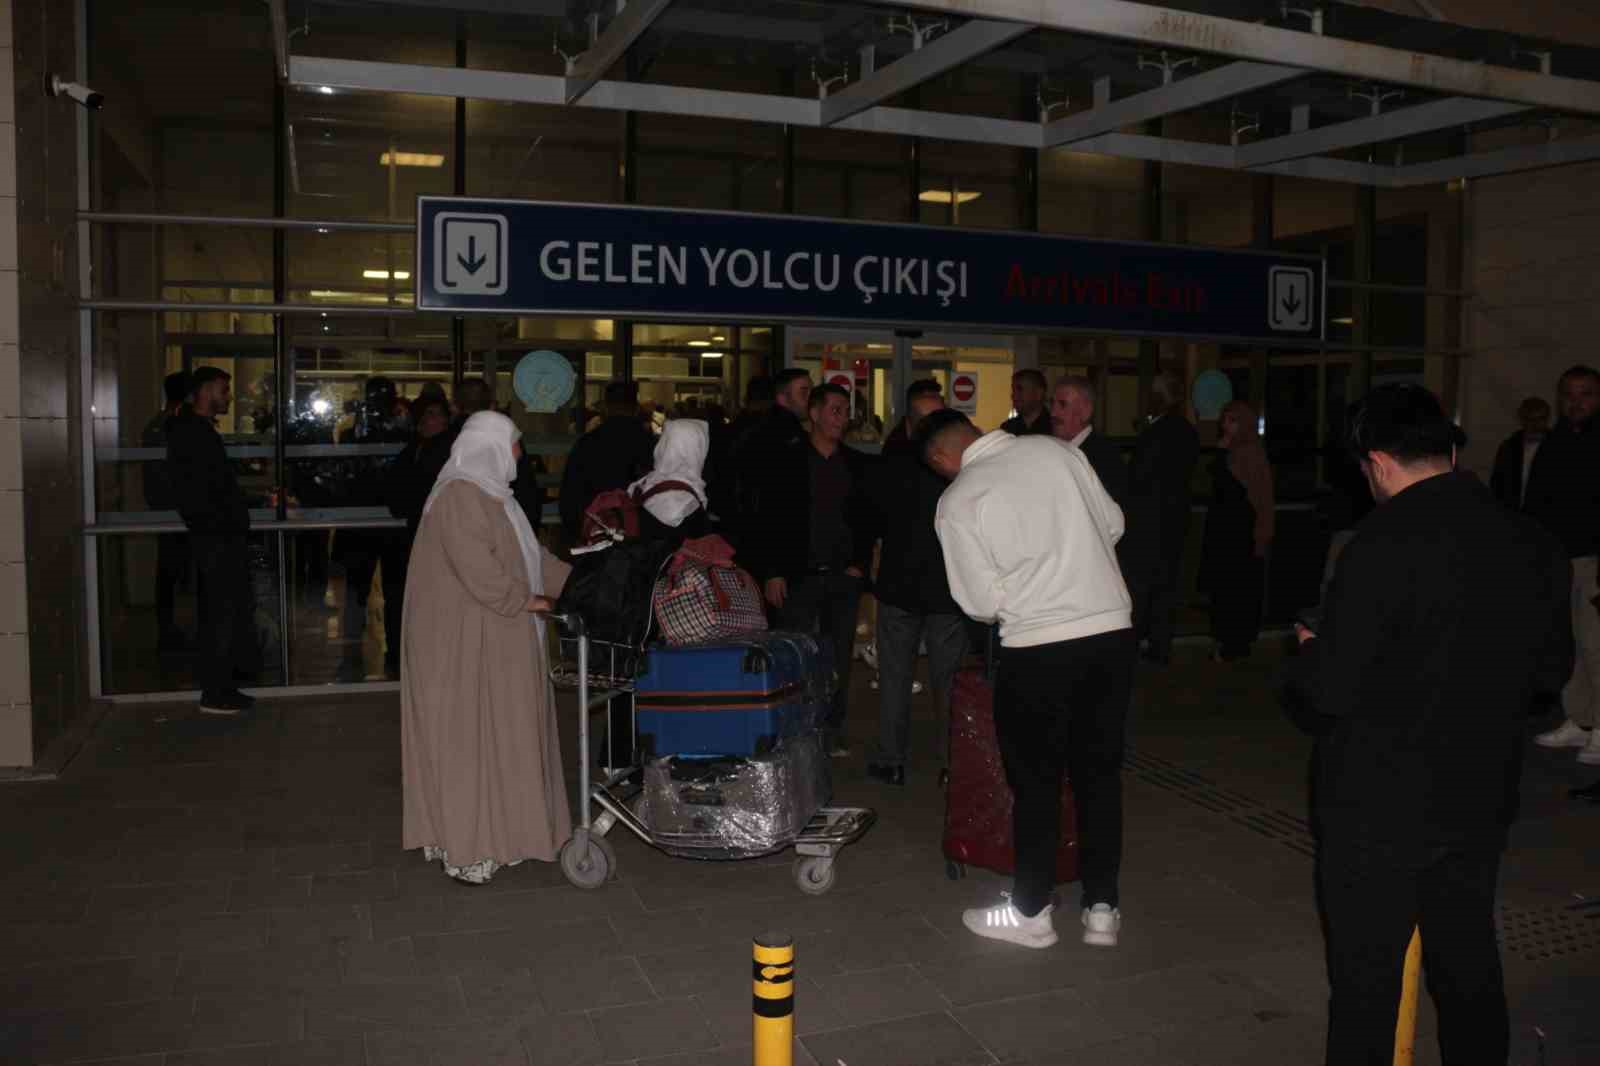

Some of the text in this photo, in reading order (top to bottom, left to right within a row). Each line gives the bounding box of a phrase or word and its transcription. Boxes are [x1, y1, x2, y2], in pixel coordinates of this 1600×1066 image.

[539, 240, 969, 307] GELEN YOLCU ÇIKIŞI
